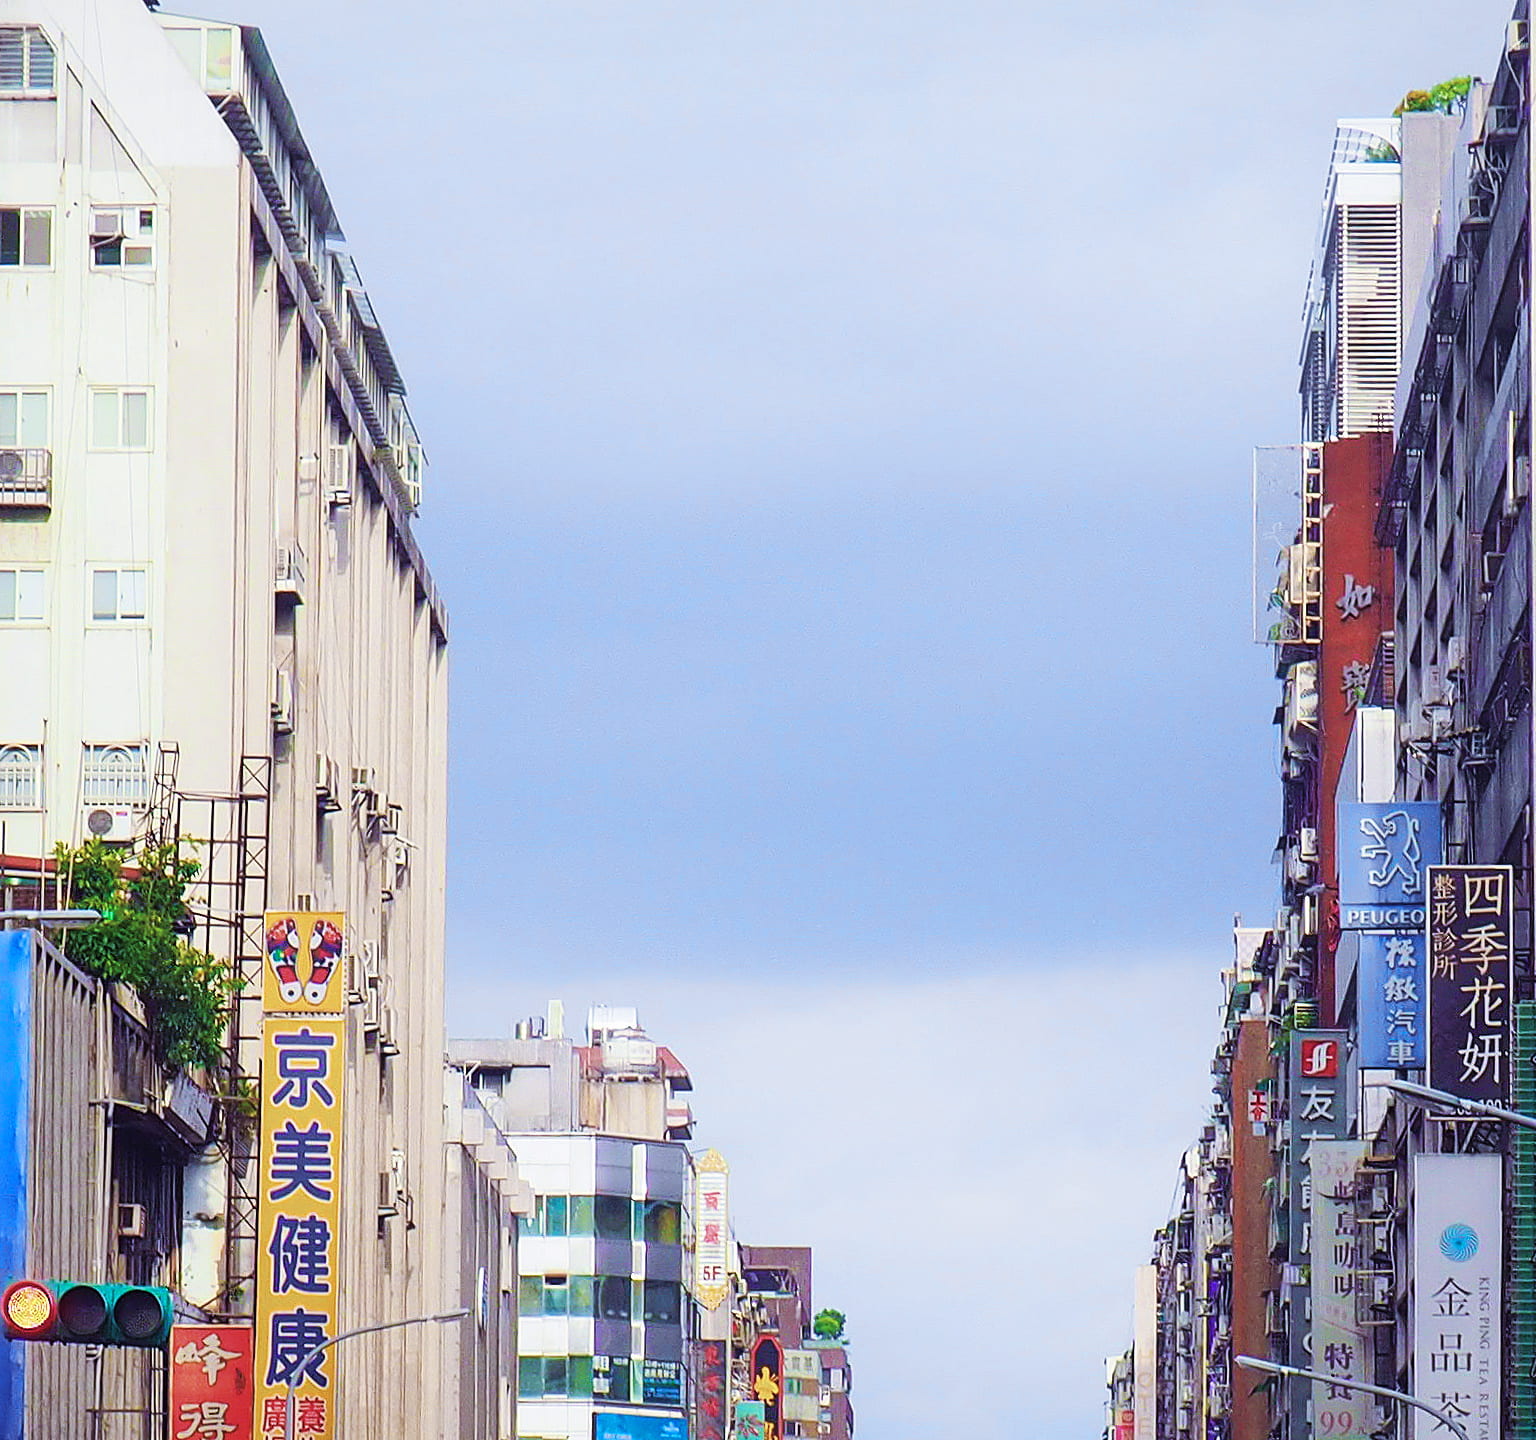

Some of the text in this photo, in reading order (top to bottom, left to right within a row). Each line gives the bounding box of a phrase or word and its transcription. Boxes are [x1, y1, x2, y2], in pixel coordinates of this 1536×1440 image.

[1431, 873, 1458, 981] 整形診所
[1458, 873, 1508, 1083] 四季花妍
[266, 1027, 335, 1388] 京美健康
[1478, 1276, 1490, 1312] KING
[1478, 1316, 1490, 1350] PING
[1478, 1359, 1490, 1386] TEA
